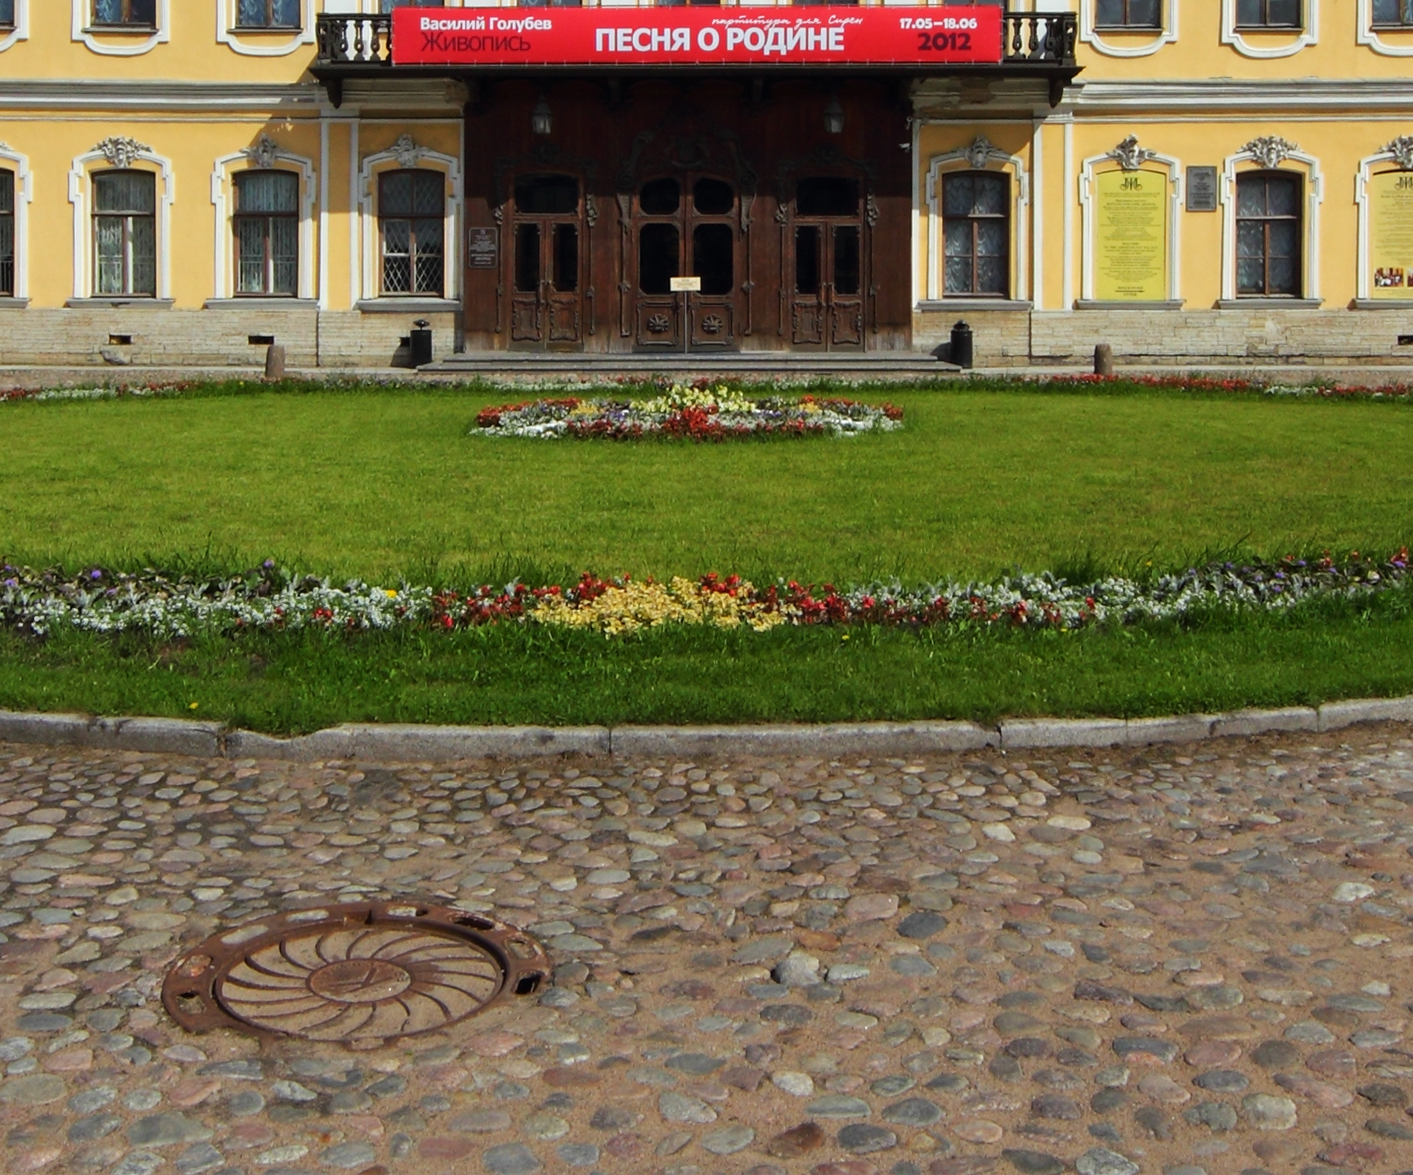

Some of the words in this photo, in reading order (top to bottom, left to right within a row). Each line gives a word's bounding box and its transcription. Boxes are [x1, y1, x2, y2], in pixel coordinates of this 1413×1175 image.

[420, 16, 485, 31] Василий
[489, 17, 552, 33] Голубев
[828, 14, 864, 29] Сирен
[420, 32, 531, 52] Живопись
[595, 27, 691, 52] ПЕСНЯ
[697, 27, 720, 52] О
[726, 27, 845, 56] РОДИНЕ
[918, 32, 972, 51] 2012
